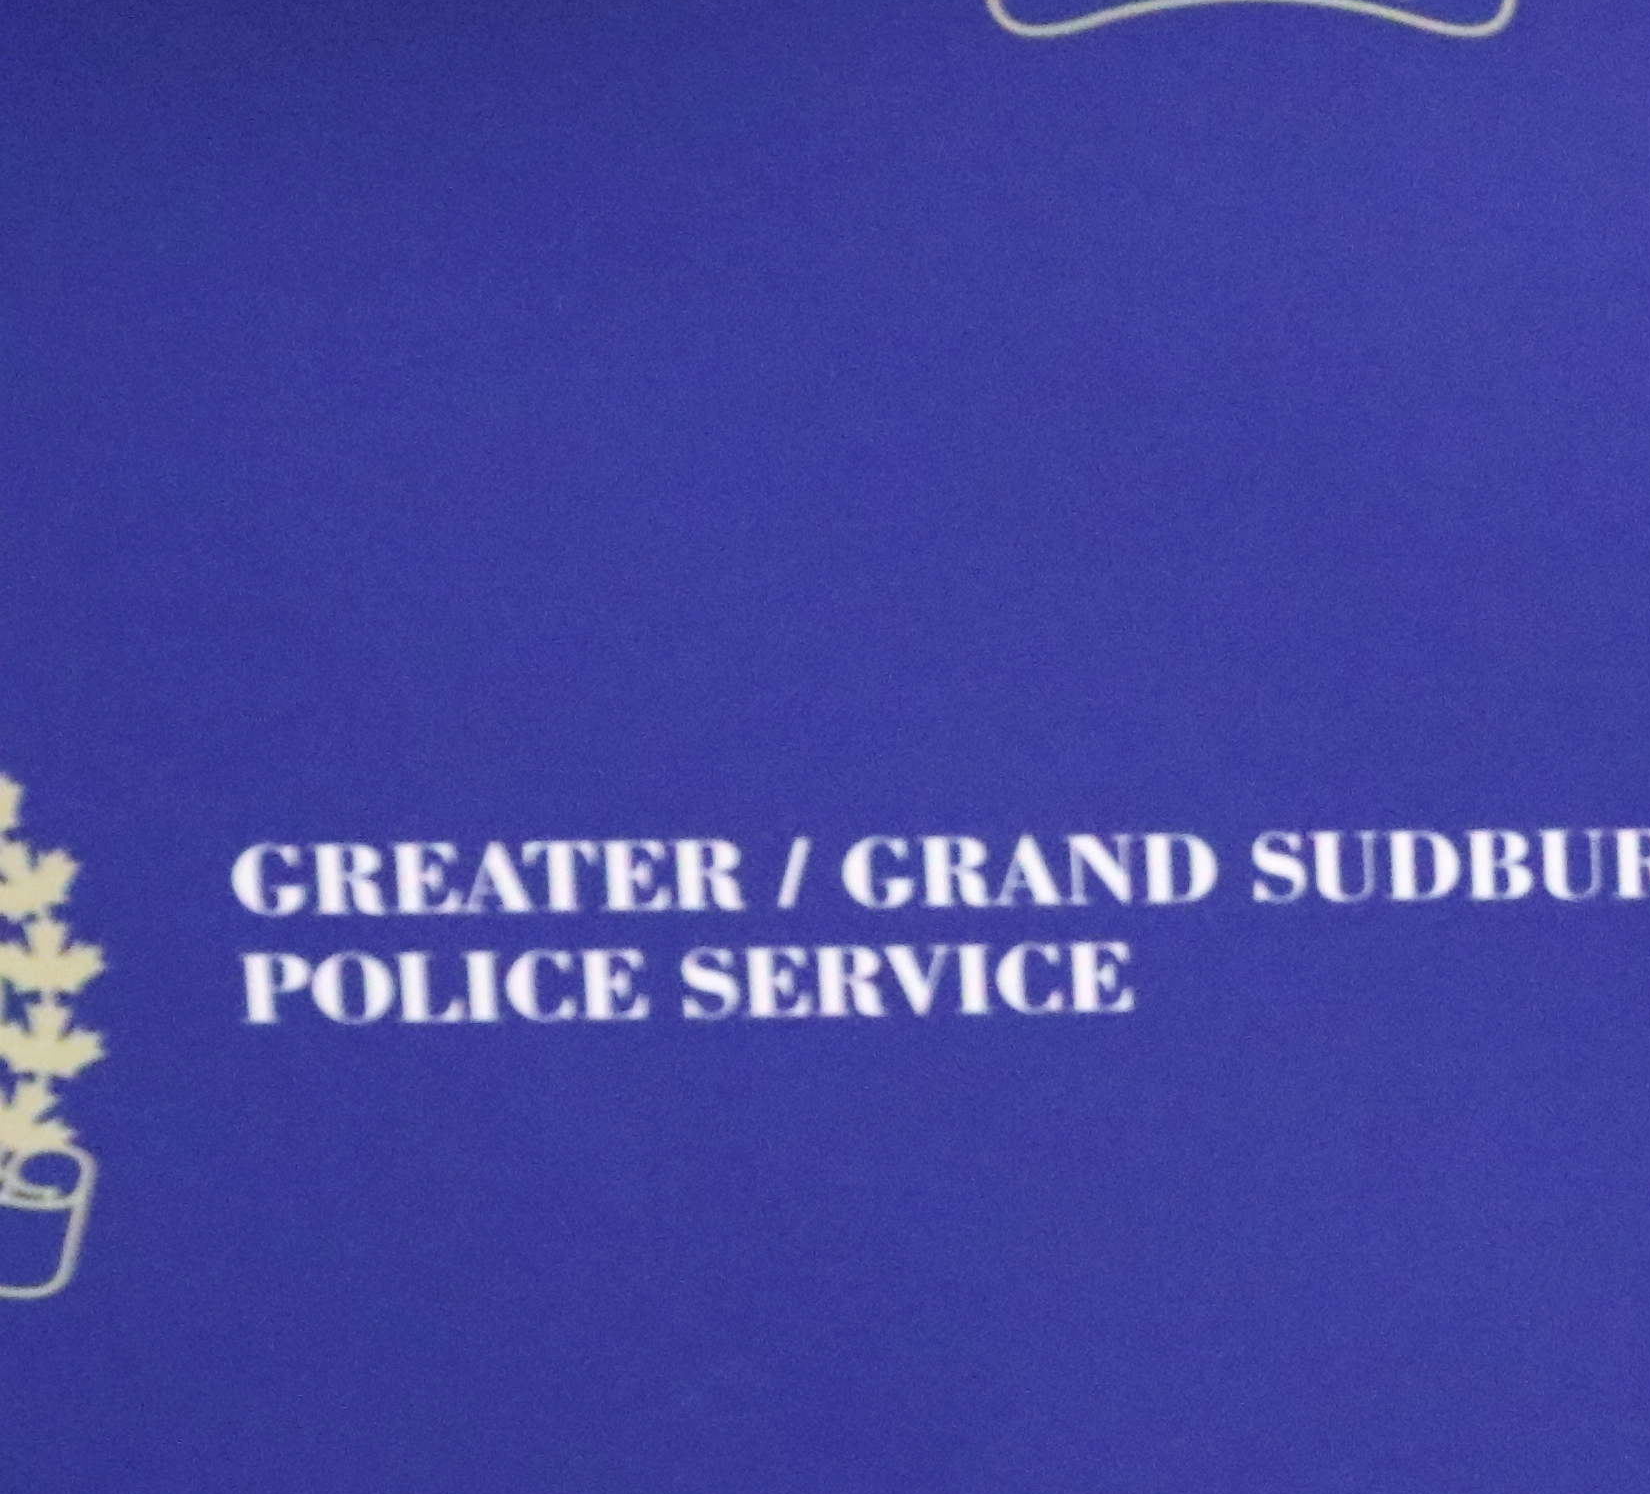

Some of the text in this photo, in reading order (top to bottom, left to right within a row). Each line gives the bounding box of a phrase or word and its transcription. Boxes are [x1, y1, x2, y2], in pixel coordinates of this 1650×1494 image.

[231, 839, 744, 916] GREATER
[778, 836, 811, 909] /
[842, 832, 1218, 908] GRAND
[243, 941, 1134, 1024] POLICE SERVICE
